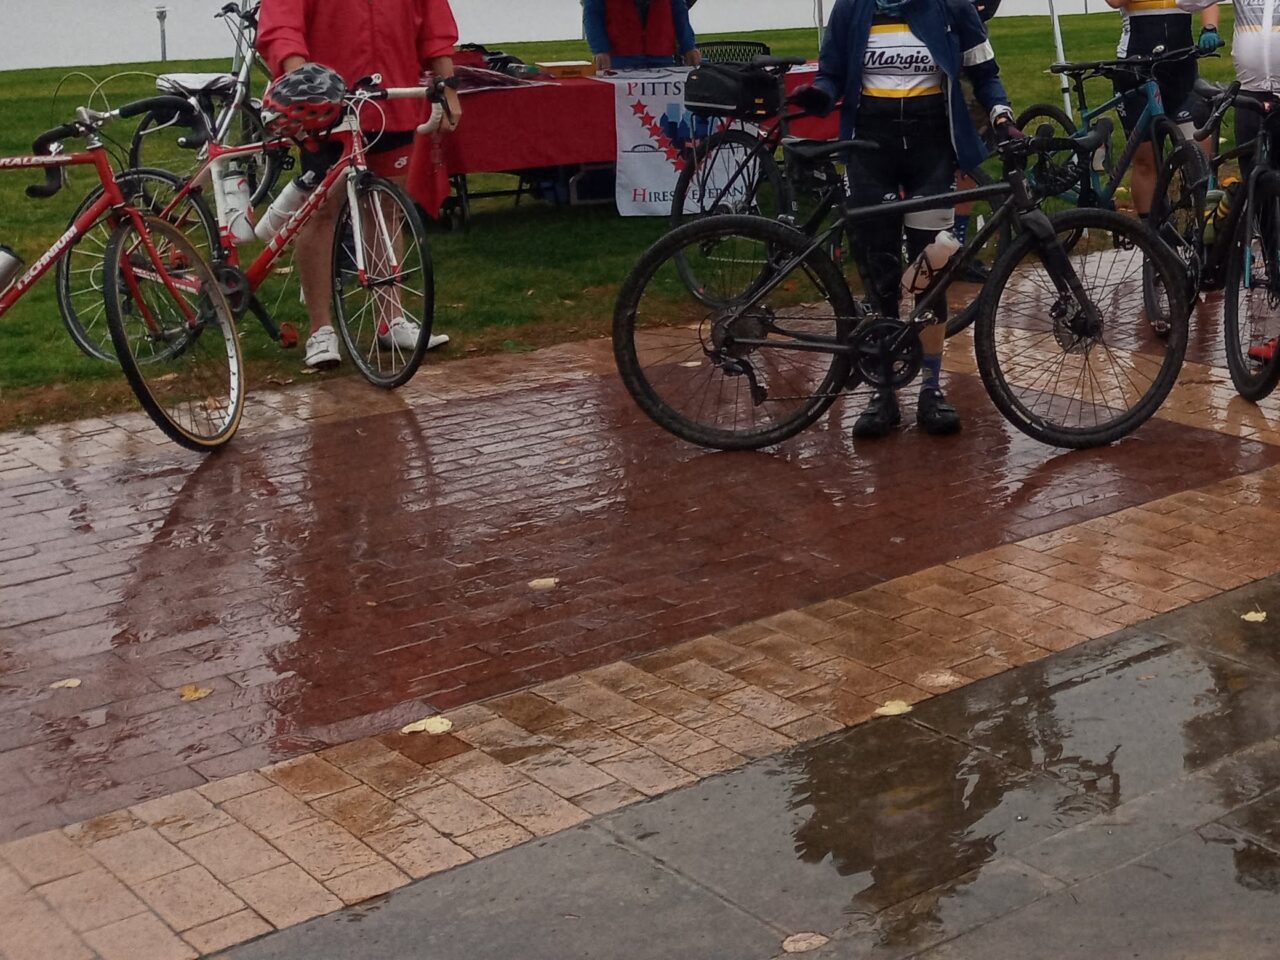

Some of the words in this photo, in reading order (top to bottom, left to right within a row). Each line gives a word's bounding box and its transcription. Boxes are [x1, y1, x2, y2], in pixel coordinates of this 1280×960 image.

[863, 50, 932, 70] Margie
[626, 81, 684, 97] PITTS
[15, 223, 79, 290] TECHNIUM
